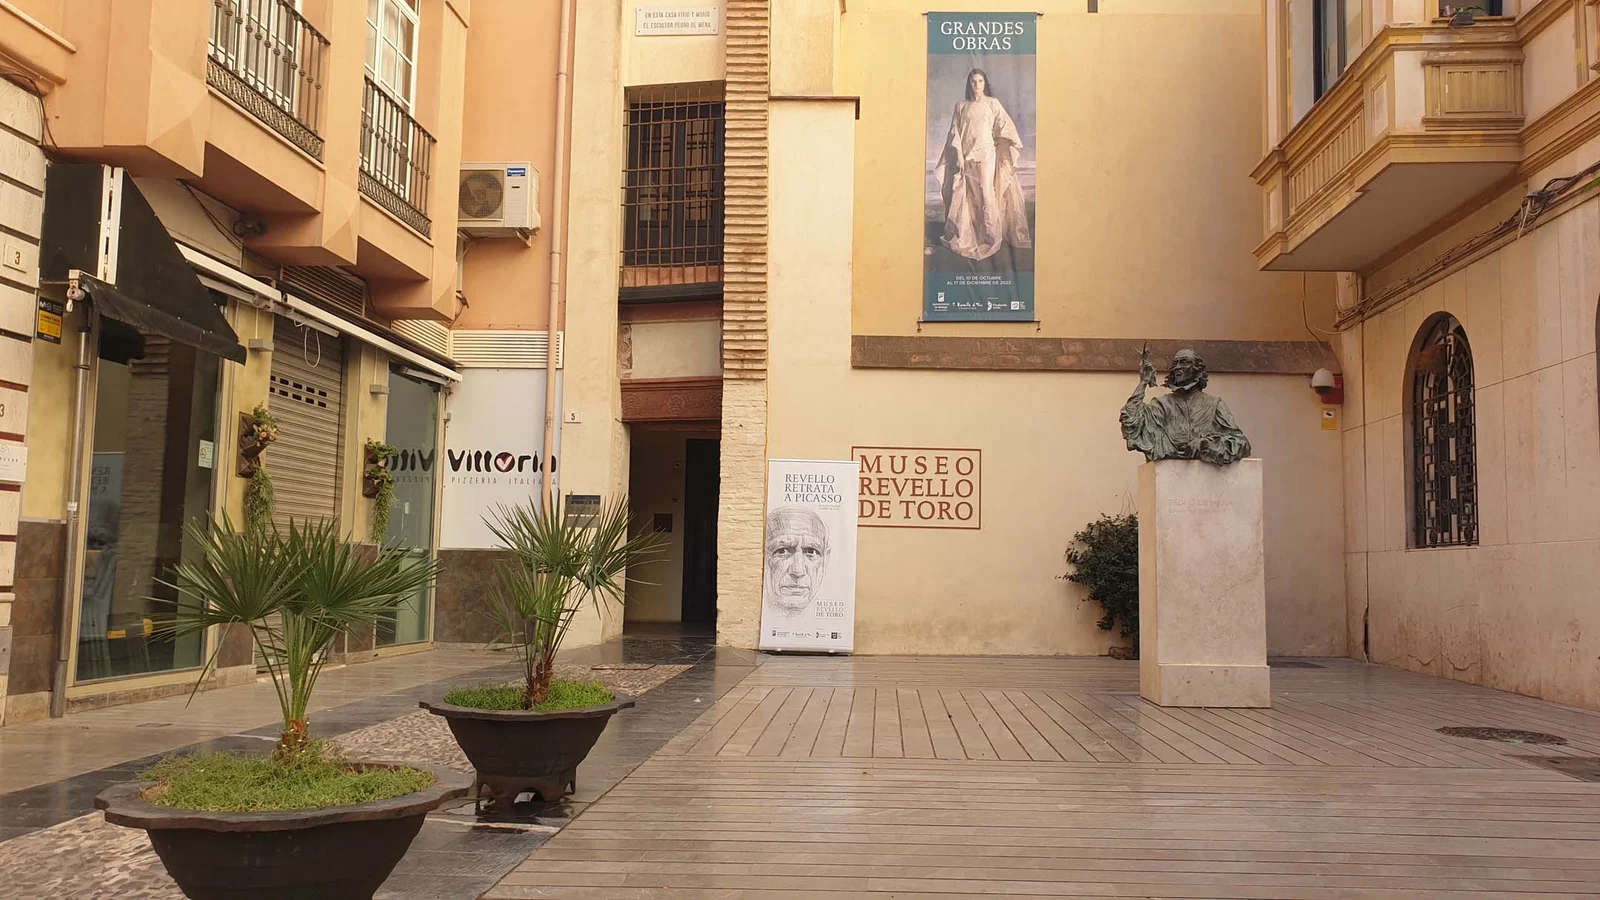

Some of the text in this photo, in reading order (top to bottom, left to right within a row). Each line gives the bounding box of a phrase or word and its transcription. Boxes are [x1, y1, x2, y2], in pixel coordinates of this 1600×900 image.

[940, 21, 1024, 35] GRANDES
[952, 37, 1012, 50] OBRAS
[15, 251, 21, 266] 3
[571, 413, 576, 421] 5
[859, 454, 974, 476] MUSEO
[451, 476, 557, 486] PIZZERIA ITALIAA
[785, 474, 835, 484] REVELLO
[784, 483, 835, 493] RETRATA
[858, 476, 974, 498] REVELLO
[784, 493, 842, 503] A PICASSO
[857, 499, 974, 521] DE TORO
